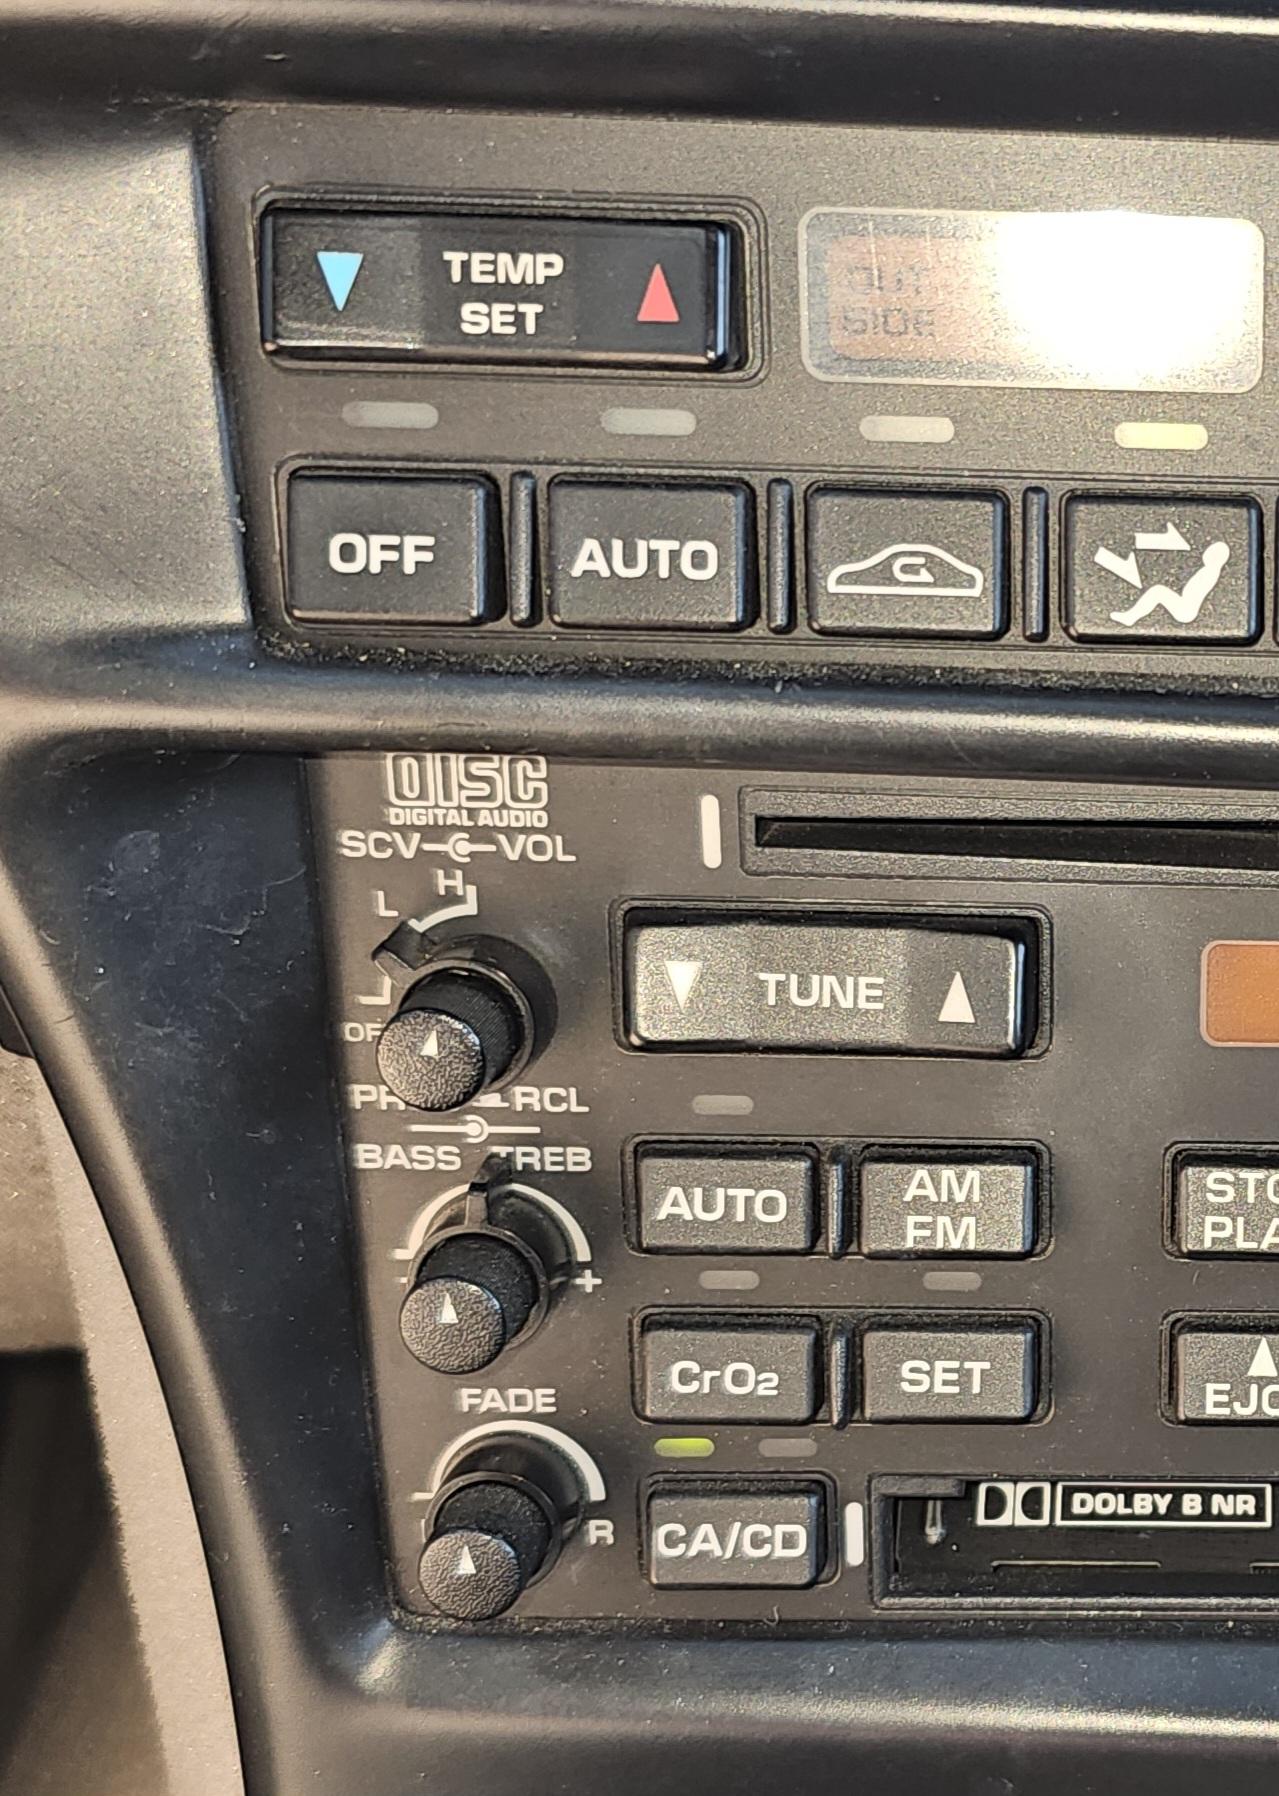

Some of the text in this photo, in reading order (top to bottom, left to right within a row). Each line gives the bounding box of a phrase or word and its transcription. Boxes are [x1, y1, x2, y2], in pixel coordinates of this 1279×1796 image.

[442, 250, 564, 285] TEMP
[460, 302, 544, 335] SET
[328, 532, 436, 575] OFF
[570, 538, 719, 581] AUTO
[389, 807, 549, 828] DIGITAL AUDIO
[340, 829, 577, 862] SCV VOL
[436, 869, 464, 896] H
[377, 890, 399, 917] L
[758, 972, 886, 1010] TUNE
[344, 1022, 385, 1042] OF
[515, 1086, 590, 1112] RCL
[355, 1144, 462, 1171] BASS
[902, 1168, 981, 1204] AM
[656, 1186, 787, 1223] AUTO
[904, 1216, 979, 1250] FM
[669, 1360, 779, 1396] CrO2
[900, 1360, 991, 1395] SET
[458, 1387, 557, 1415] FADE
[1071, 1492, 1257, 1516] DOLBY B NR
[587, 1519, 614, 1545] R
[655, 1522, 808, 1560] CA/CD
